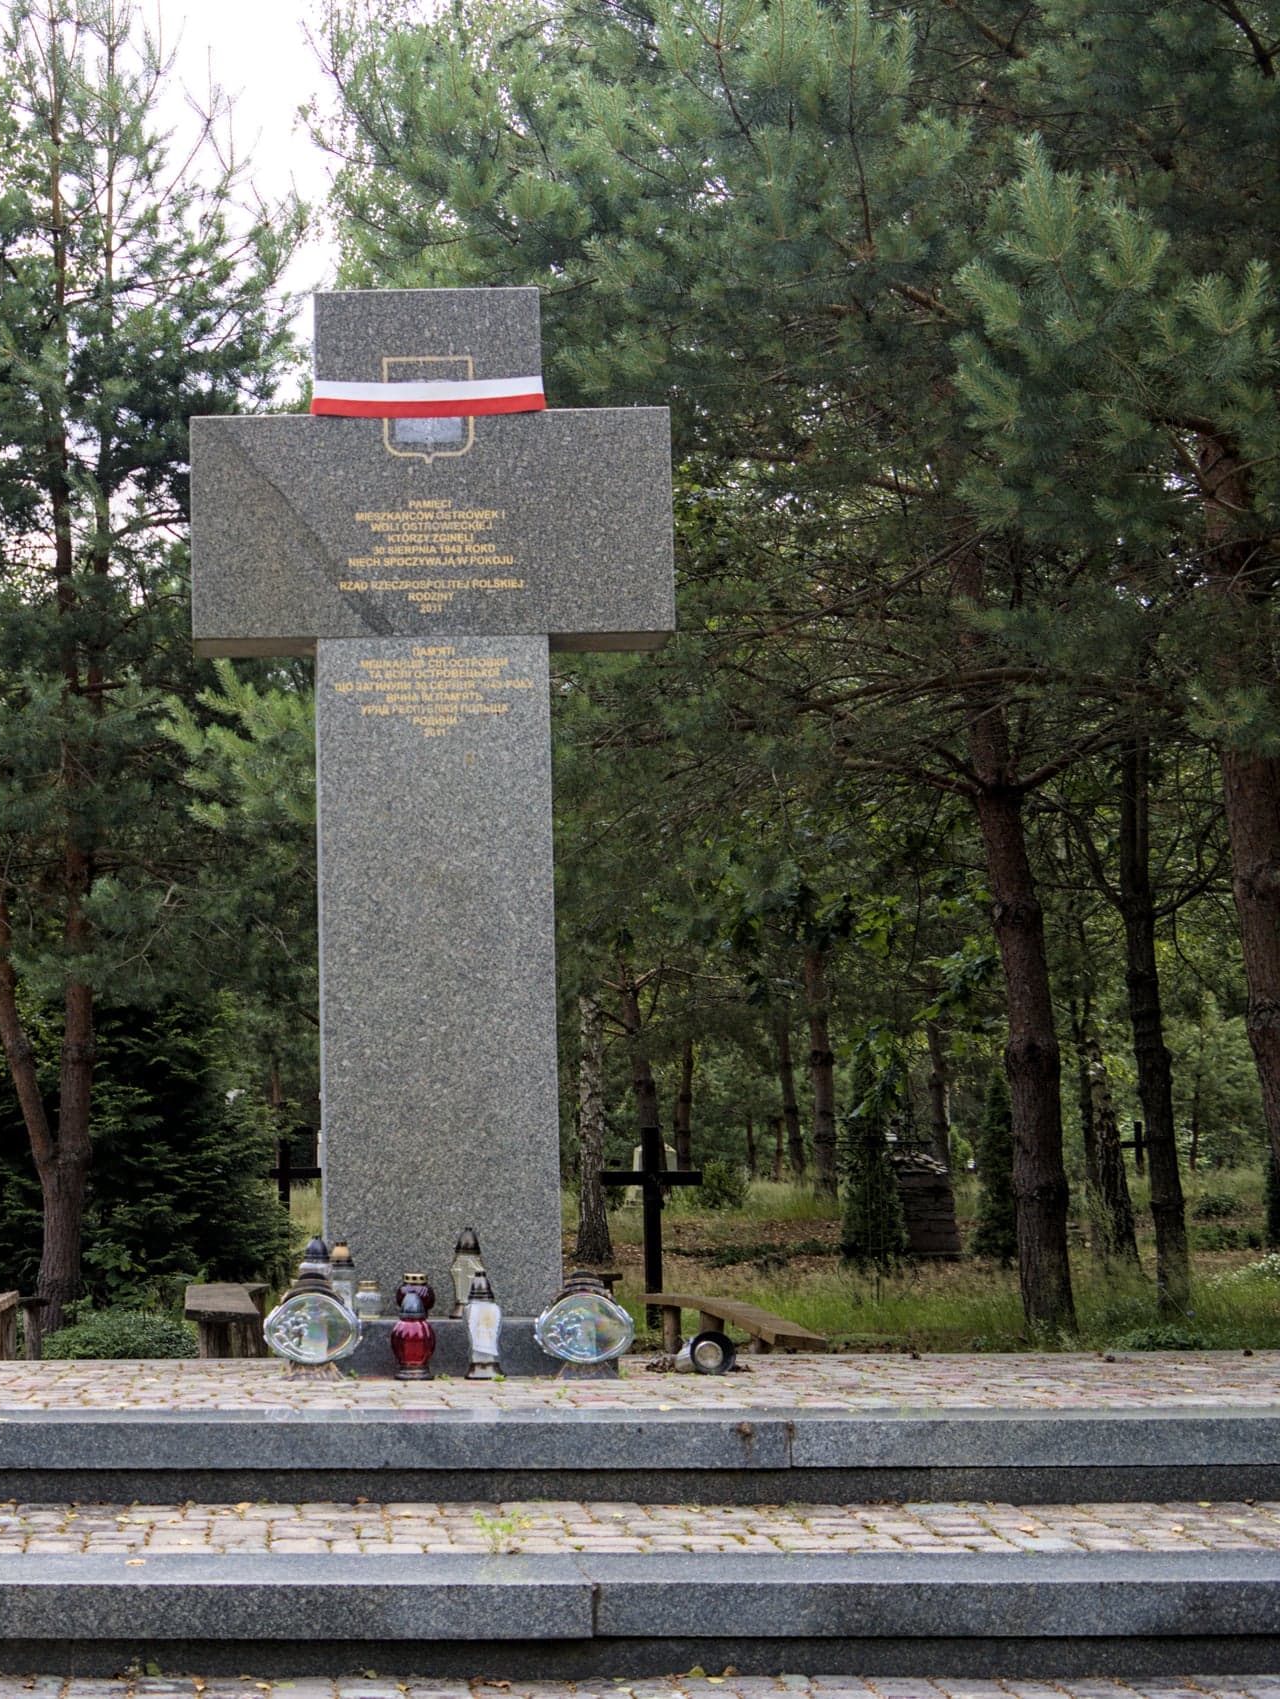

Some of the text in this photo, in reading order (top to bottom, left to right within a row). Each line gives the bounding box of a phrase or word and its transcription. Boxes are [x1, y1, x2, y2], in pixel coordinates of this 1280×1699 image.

[356, 511, 433, 521] MIESZKAŃCÓW
[436, 510, 498, 520] OSTRÓWEK
[371, 523, 399, 532] WOLI
[388, 533, 473, 543] KTÓRZY ZGINĘLI
[388, 545, 436, 554] SIERPNIA
[440, 545, 461, 553] 1943
[465, 544, 495, 553] ROKU
[348, 556, 513, 567] NIECH SPOCZYWAJĄ W POKOJU
[340, 579, 524, 592] RZĄD RZECZPOSPOLITEJ POLSKIEJ
[408, 592, 454, 601] RODZINY
[420, 604, 442, 613] 2011
